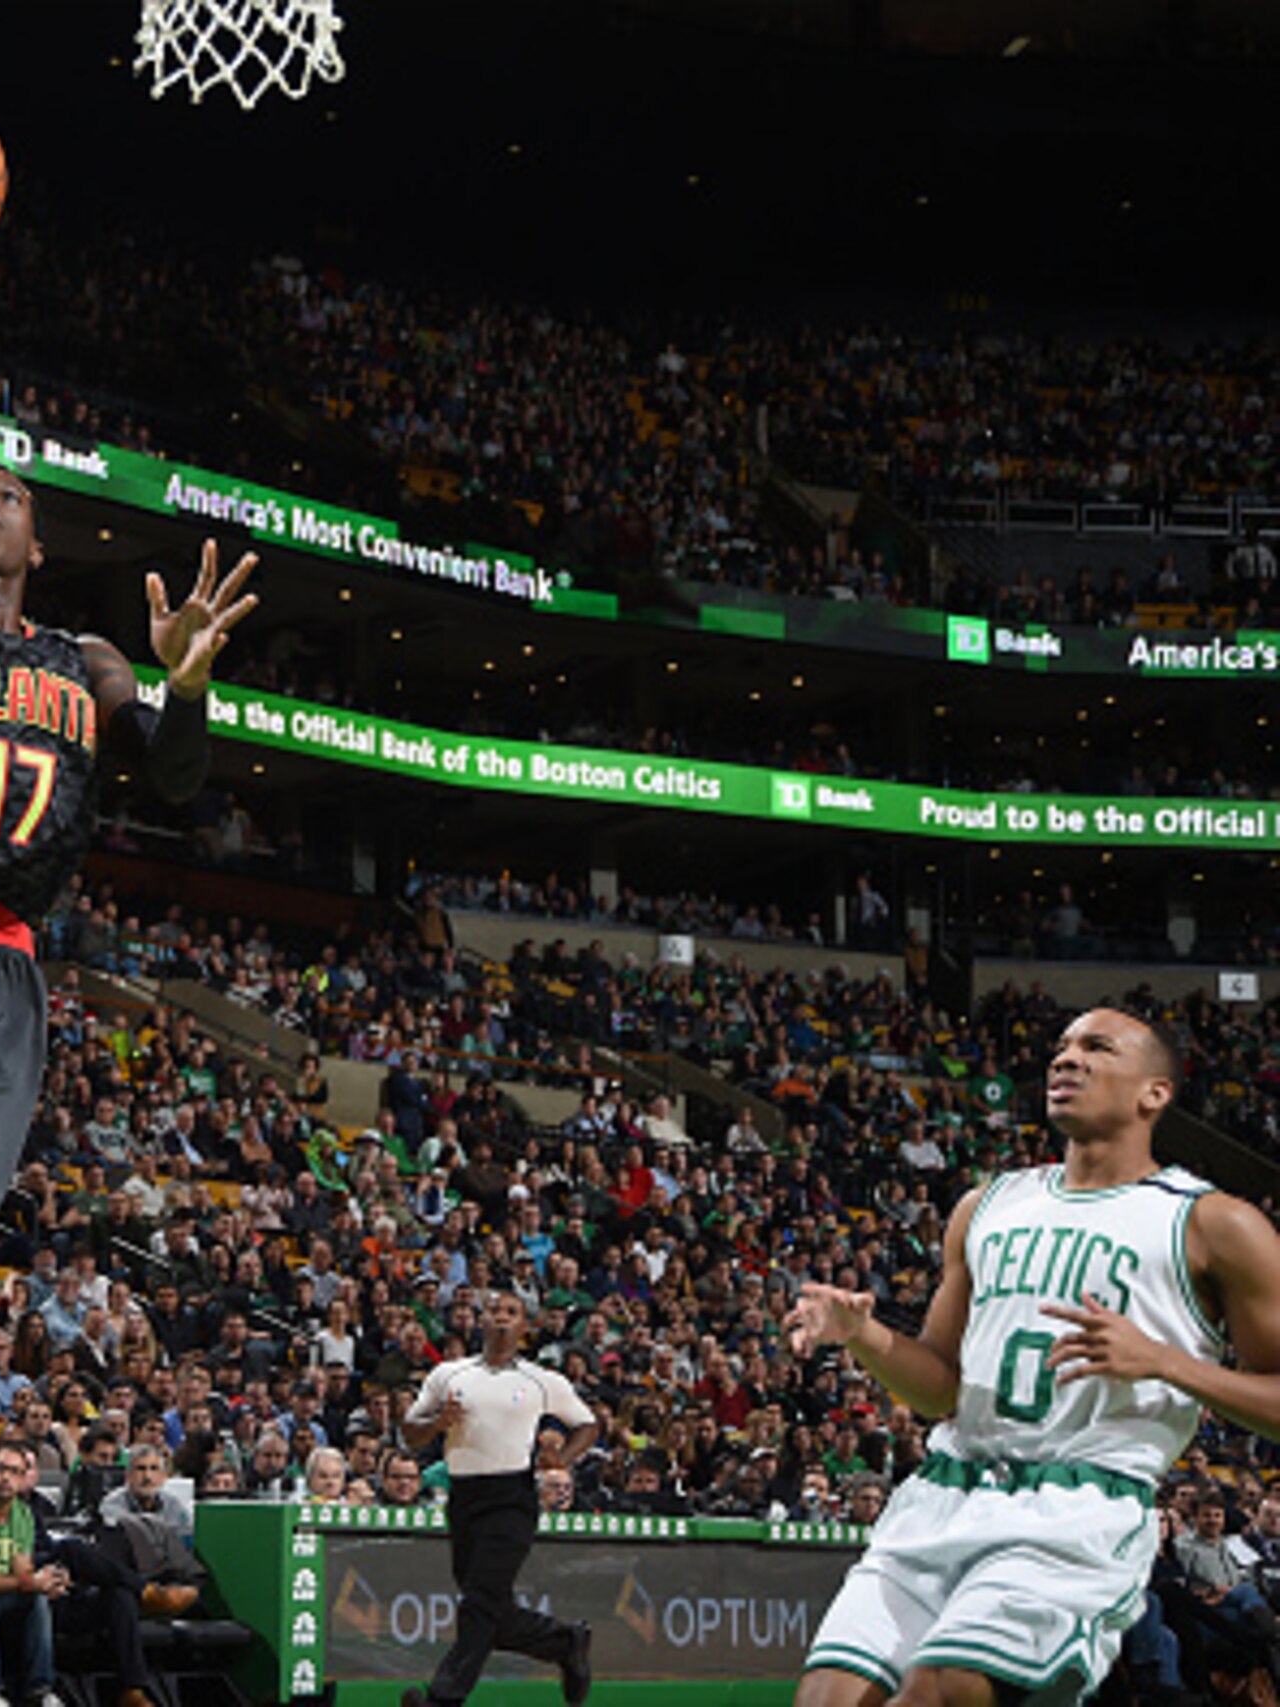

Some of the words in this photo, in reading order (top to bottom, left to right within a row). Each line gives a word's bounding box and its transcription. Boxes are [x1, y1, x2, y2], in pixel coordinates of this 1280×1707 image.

[42, 438, 109, 479] Bank
[165, 473, 285, 534] America's
[292, 507, 352, 553] Most
[358, 525, 489, 588] Convenient
[494, 559, 553, 604] Bank
[954, 624, 984, 652] TD
[995, 628, 1060, 656] Bank
[1128, 636, 1277, 669] America's
[207, 690, 238, 725] be
[245, 702, 285, 736] the
[292, 711, 376, 754] Official
[382, 730, 436, 767] Bank
[442, 746, 470, 773] of
[475, 749, 521, 779] the
[531, 754, 626, 790] Boston
[633, 766, 721, 800] Celtics
[776, 782, 807, 808] TD
[816, 785, 873, 811] Bank
[921, 797, 996, 829] Proud
[1006, 806, 1039, 830] to
[1047, 804, 1086, 833] be
[1096, 806, 1143, 833] the
[1155, 808, 1265, 837] Official
[974, 1225, 1139, 1315] CELTICS
[995, 1326, 1057, 1423] 0
[662, 1598, 808, 1648] OPTUM
